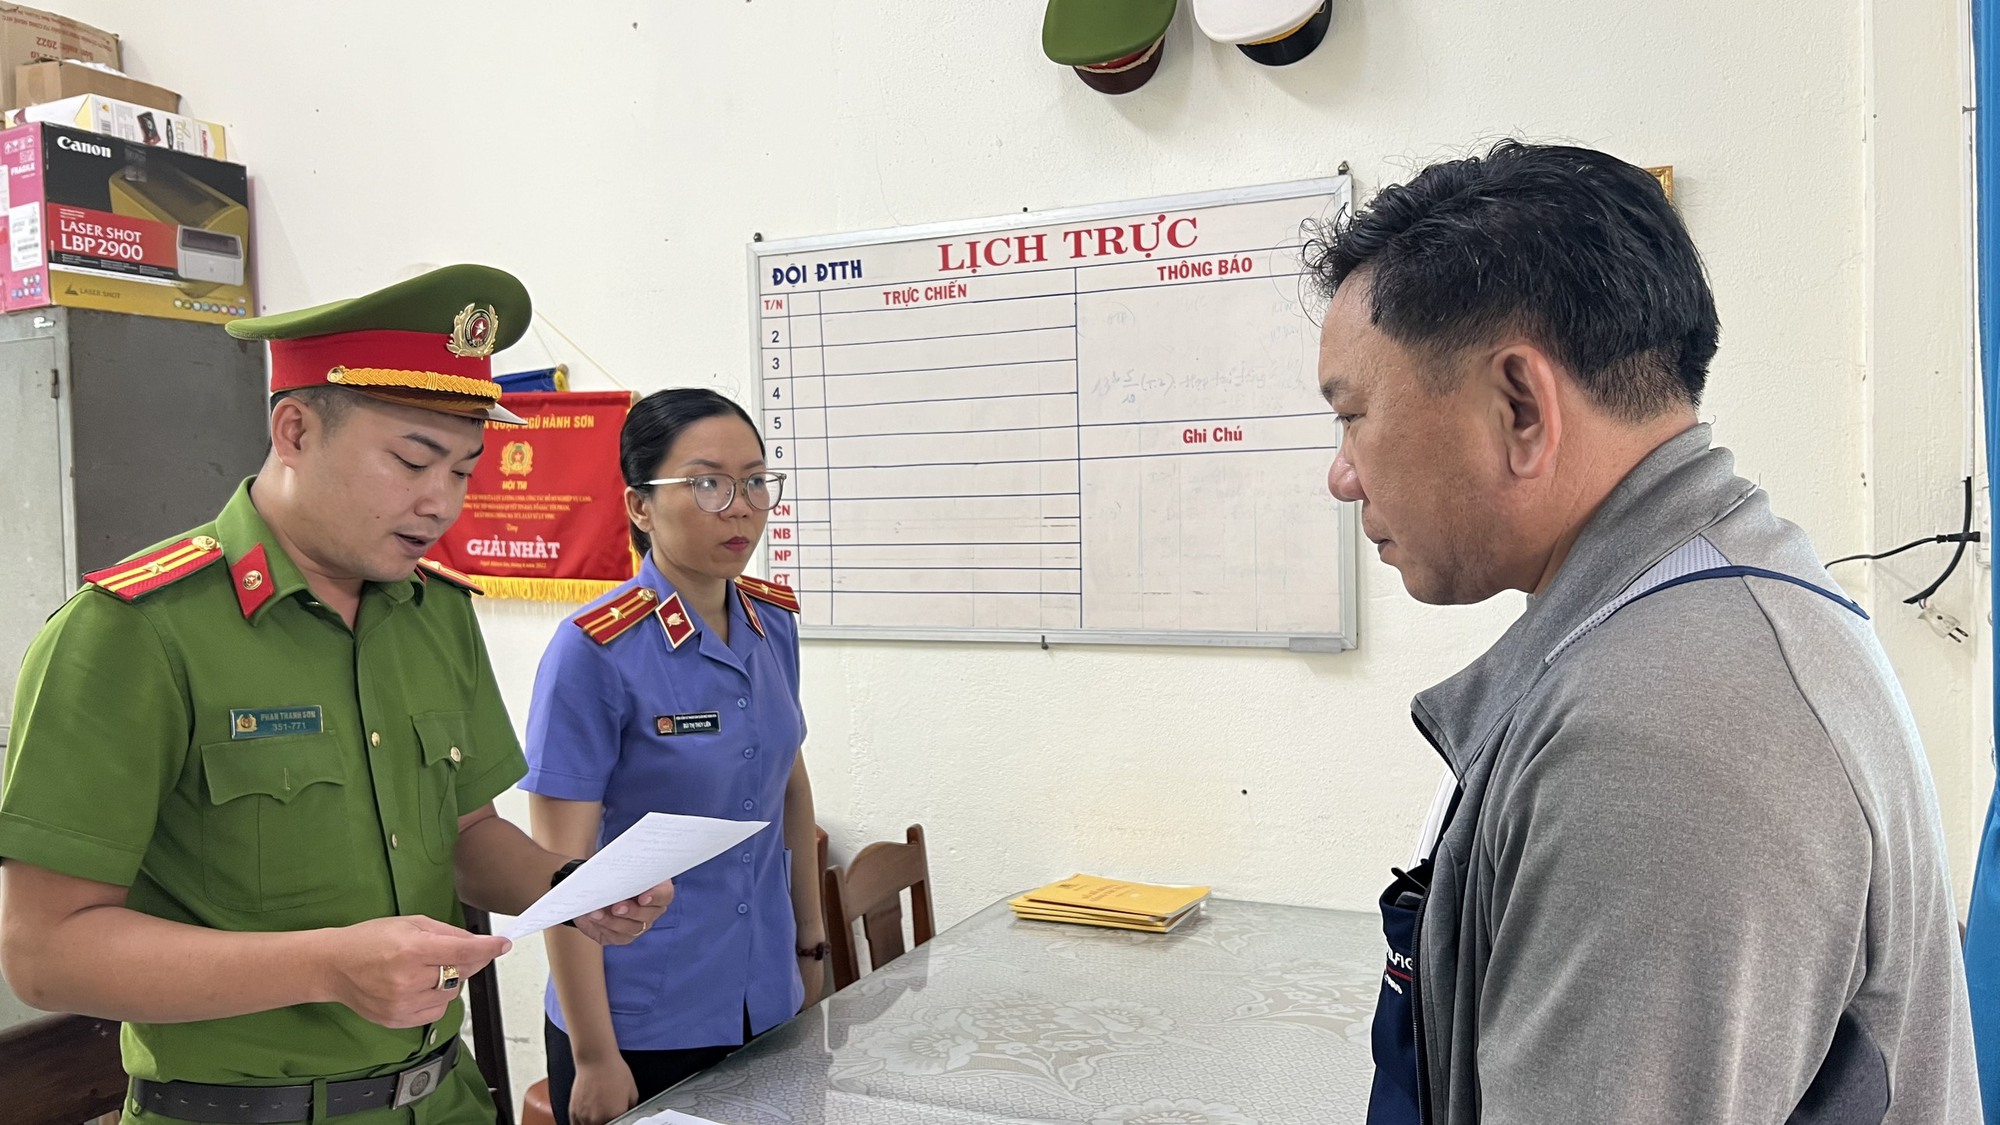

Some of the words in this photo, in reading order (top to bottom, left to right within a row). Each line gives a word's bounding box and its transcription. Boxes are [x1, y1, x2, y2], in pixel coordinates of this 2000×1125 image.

[57, 135, 111, 158] Canon
[10, 163, 36, 176] FRAGILE
[60, 219, 104, 238] LASER
[106, 227, 142, 243] SHOT
[61, 233, 96, 253] LBP
[97, 239, 143, 261] 2900
[937, 233, 1048, 274] LỊCH
[1063, 214, 1198, 259] TRỰC
[772, 263, 808, 288] ĐỘI
[814, 259, 863, 282] ĐTTH
[1157, 260, 1213, 282] THÔNG
[1218, 254, 1253, 275] BÁO
[80, 287, 101, 297] LASER
[103, 289, 120, 299] SHOT
[883, 286, 920, 307] TRỰC
[925, 280, 967, 301] CHIẾN
[764, 299, 783, 311] T/N
[771, 330, 780, 343] 2
[772, 357, 780, 370] 3
[772, 387, 781, 400] 4
[542, 413, 571, 428] HÀNH
[574, 414, 594, 428] SƠN
[774, 417, 782, 430] 5
[1183, 428, 1207, 444] Ghi
[1213, 425, 1243, 442] Chú
[775, 446, 783, 459] 6
[773, 504, 791, 516] CN
[773, 528, 791, 540] NB
[466, 534, 507, 557] GIẢI
[509, 535, 560, 558] NHẤT
[774, 550, 791, 562] NP
[774, 573, 790, 585] CT
[260, 713, 279, 721] PHAN
[280, 711, 302, 719] THANH
[271, 721, 306, 731] 351-771
